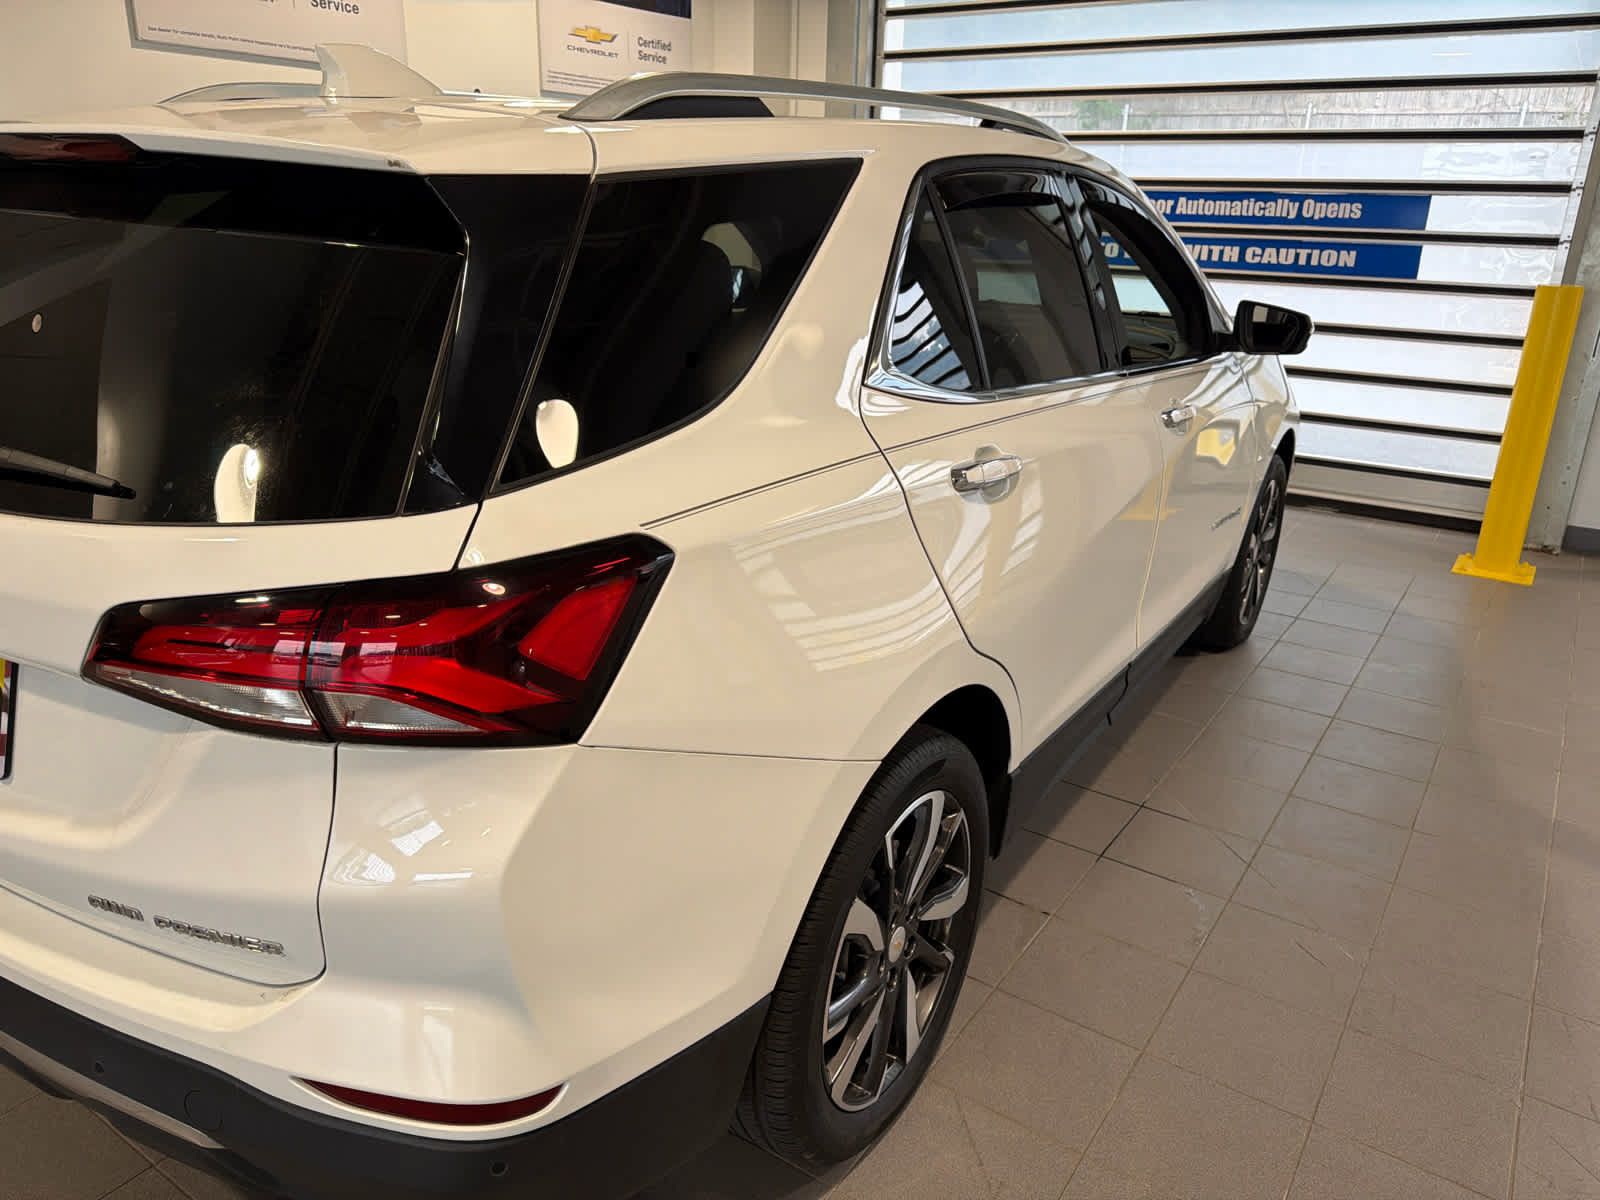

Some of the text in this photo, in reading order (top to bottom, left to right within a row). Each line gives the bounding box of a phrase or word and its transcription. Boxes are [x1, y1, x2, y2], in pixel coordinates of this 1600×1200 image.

[310, 0, 360, 15] Service
[566, 44, 619, 59] CHEVROLET
[637, 36, 672, 52] Certified
[637, 50, 667, 65] Service
[1175, 197, 1300, 219] Automatically
[1302, 199, 1363, 220] Opens
[1244, 246, 1357, 268] CAUTION
